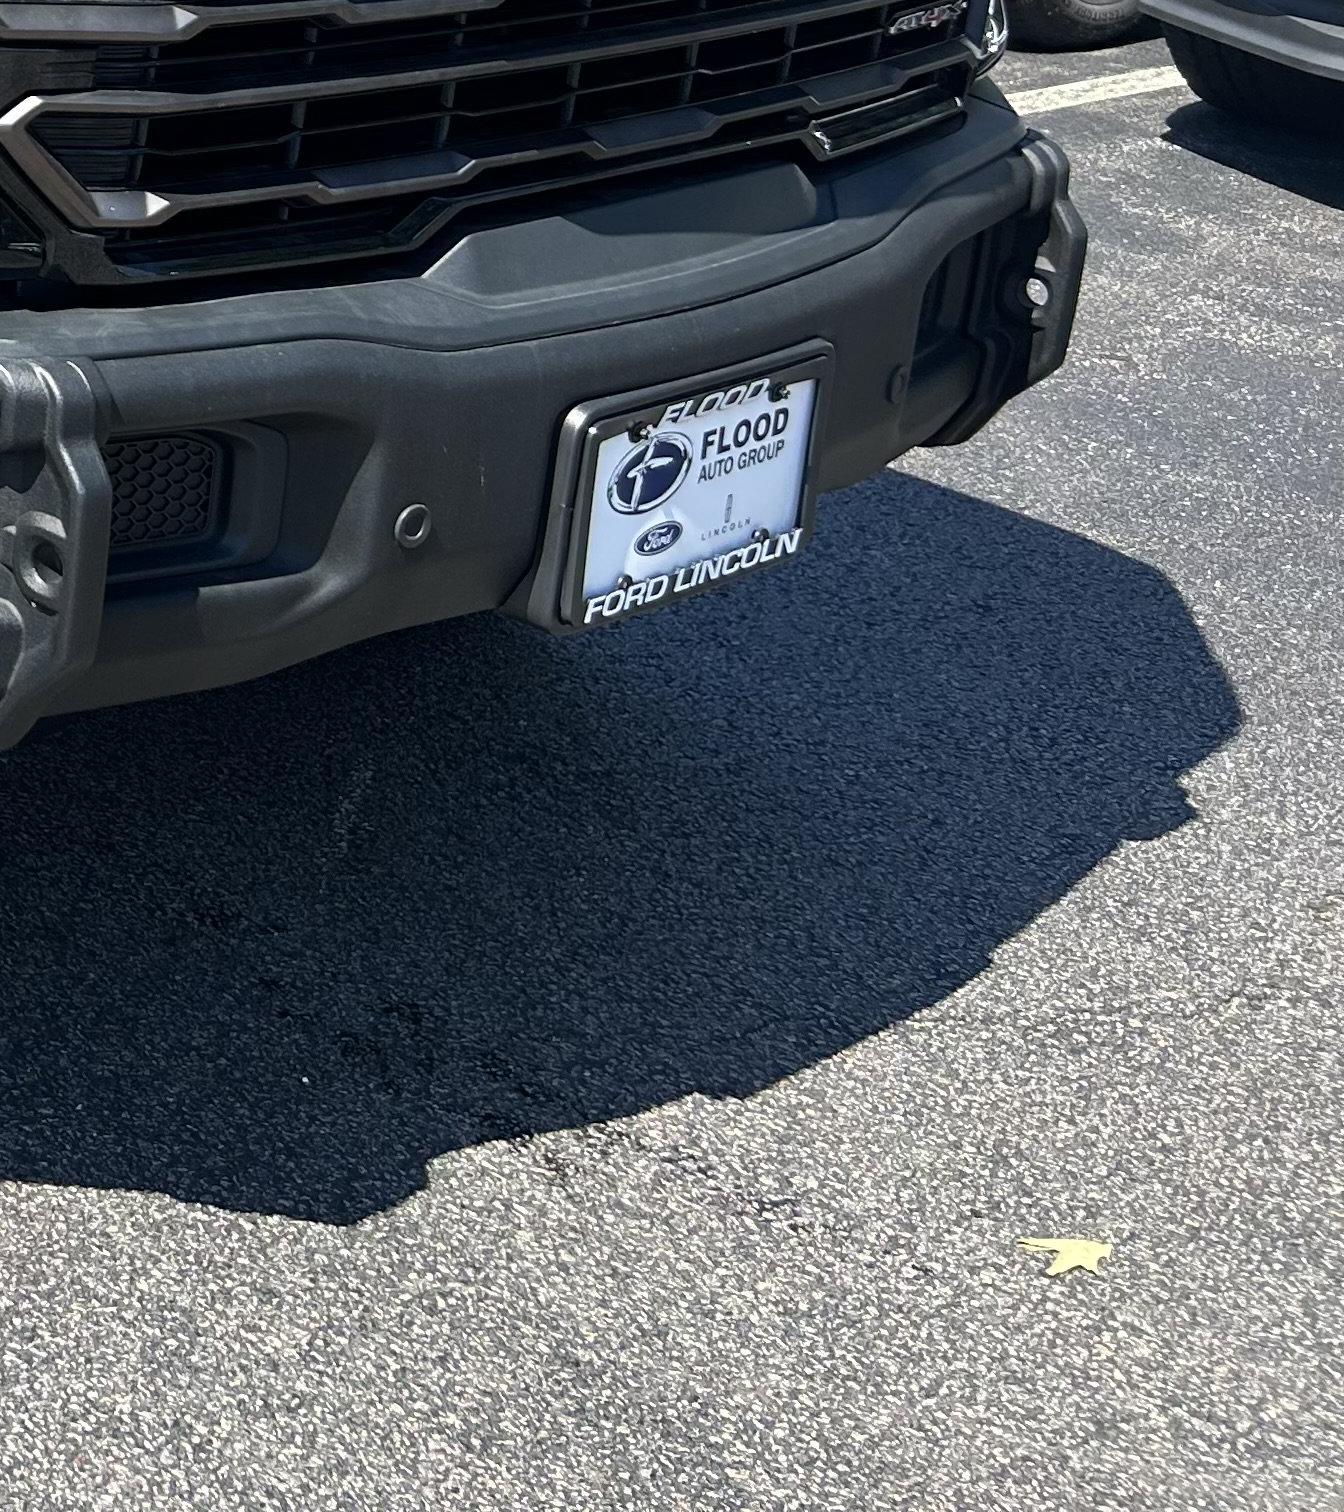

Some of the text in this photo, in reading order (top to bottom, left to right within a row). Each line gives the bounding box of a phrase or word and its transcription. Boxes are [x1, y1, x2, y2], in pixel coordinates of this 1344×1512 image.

[657, 378, 770, 427] FLOOD
[700, 407, 789, 460] FLOOD
[697, 439, 785, 484] AUTO GROUP
[643, 528, 675, 551] Ford
[700, 516, 751, 541] LINCOLN
[583, 528, 803, 624] FORD LINCOLN
